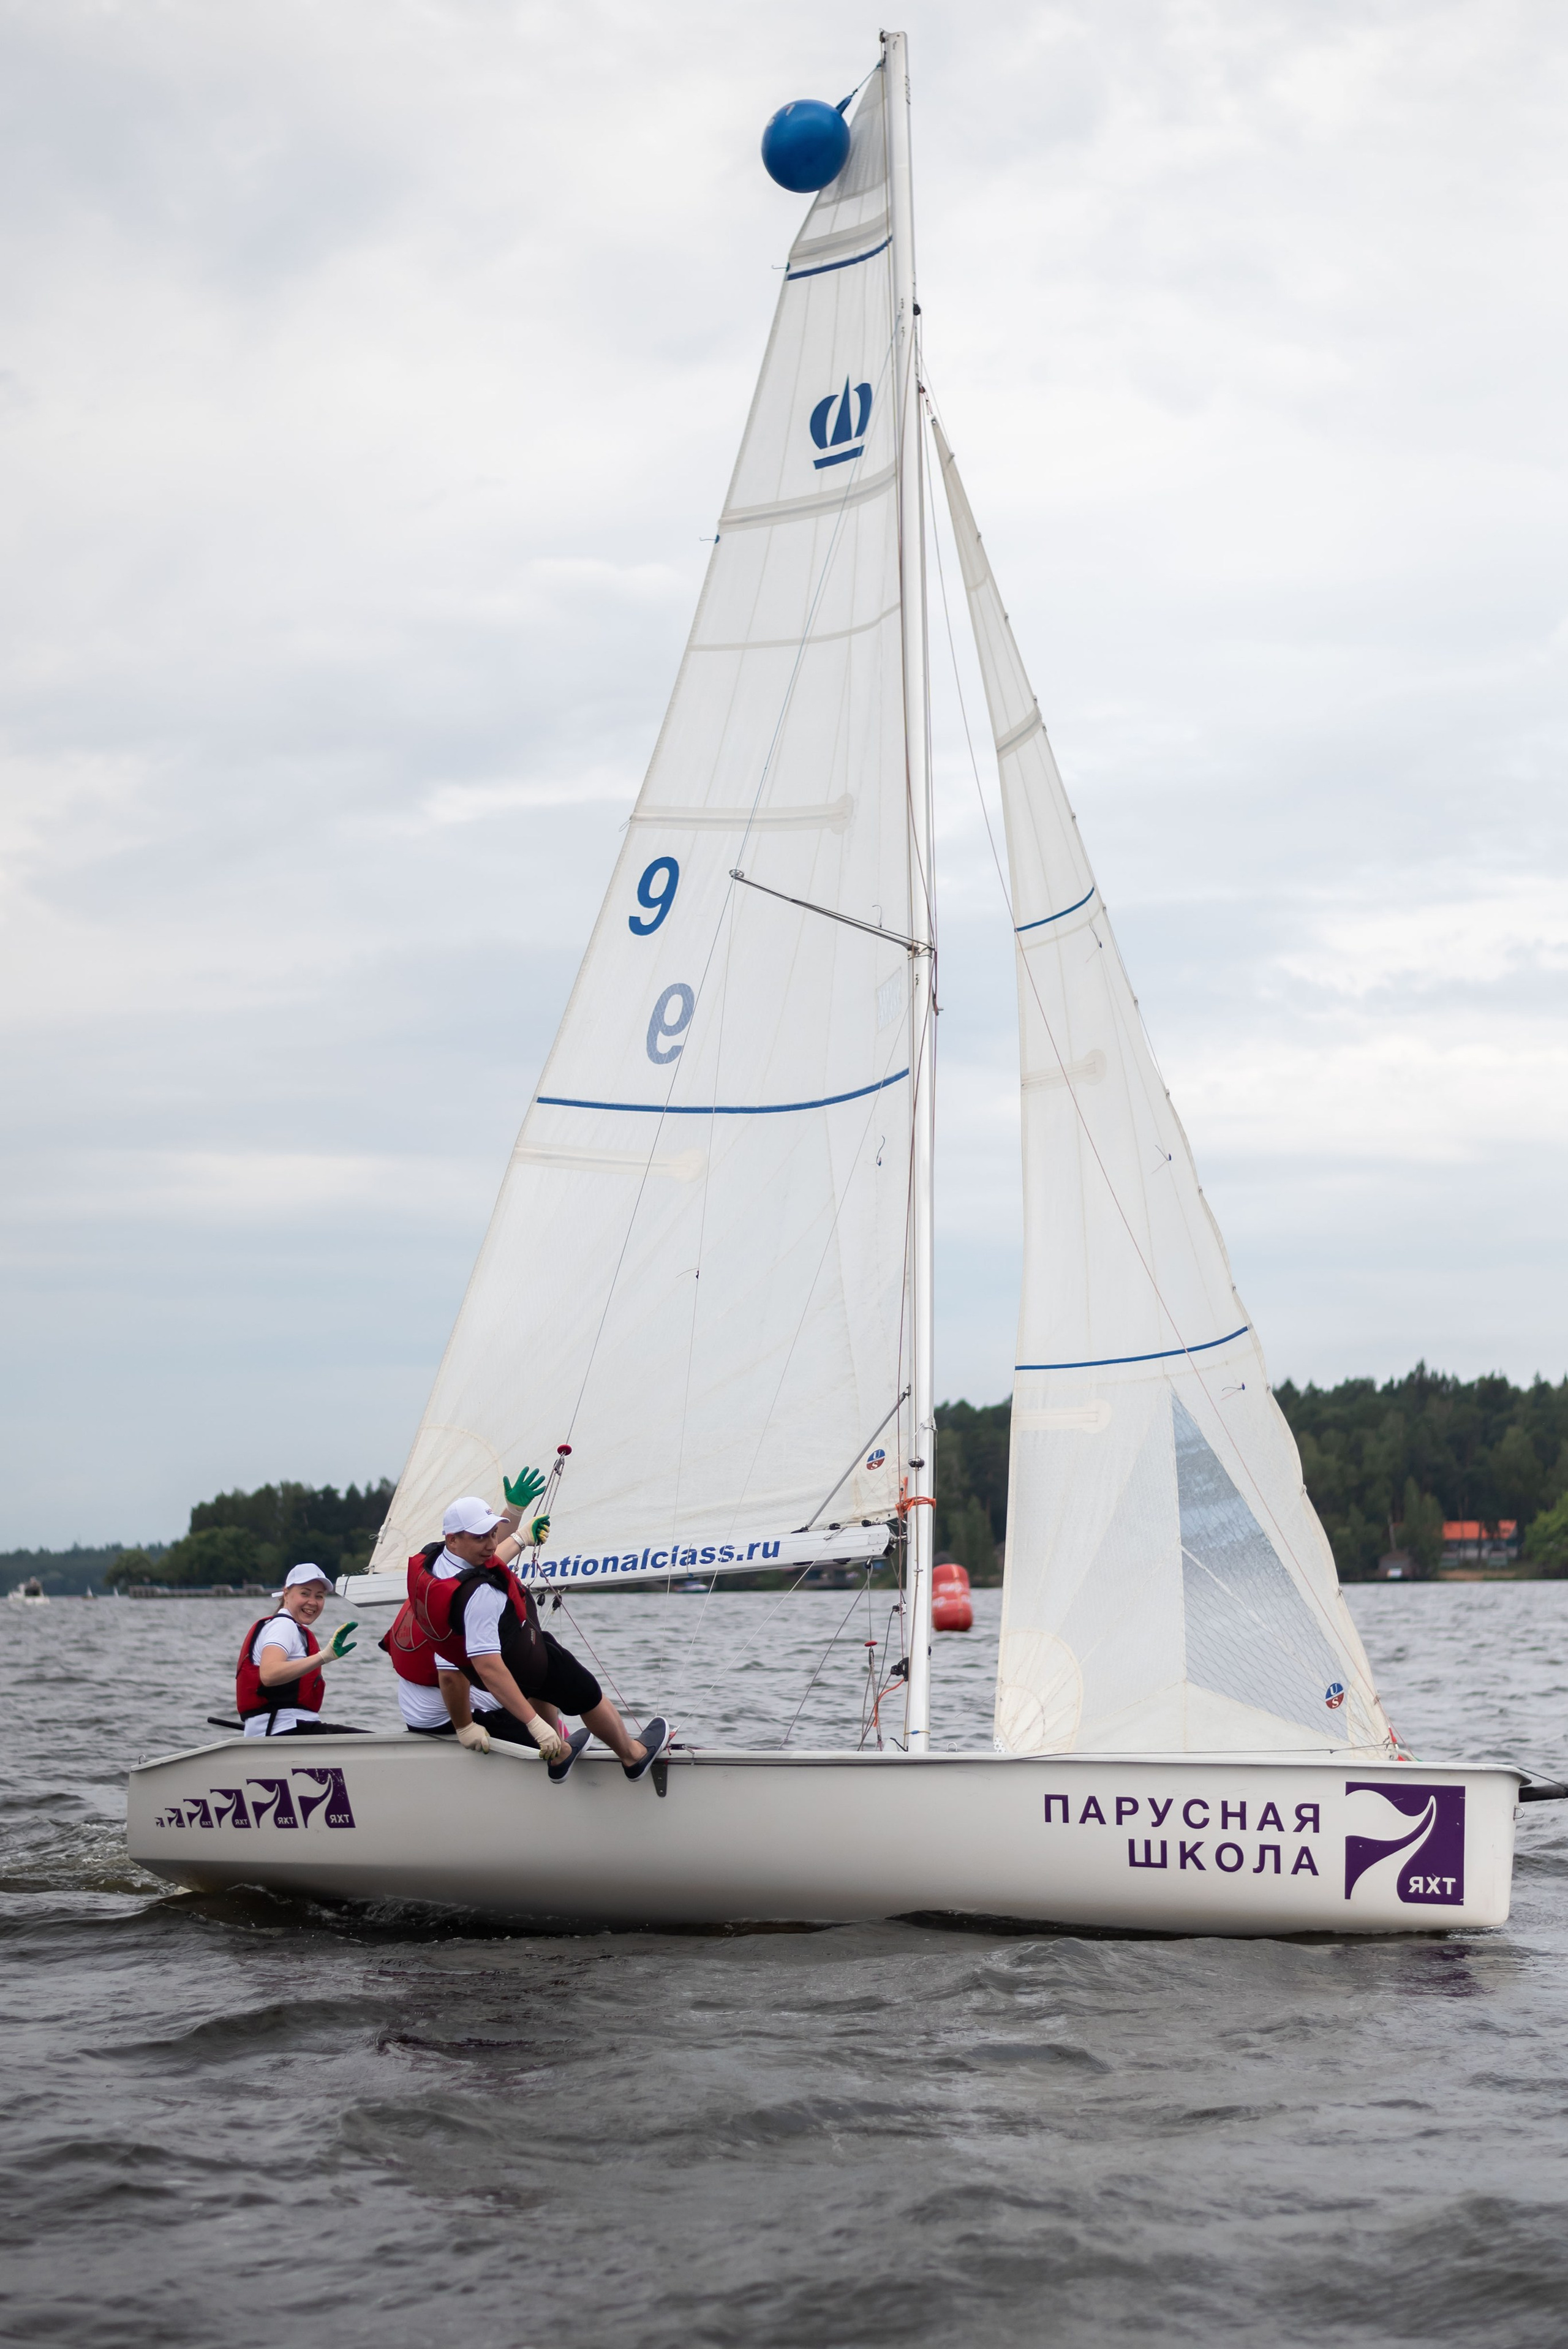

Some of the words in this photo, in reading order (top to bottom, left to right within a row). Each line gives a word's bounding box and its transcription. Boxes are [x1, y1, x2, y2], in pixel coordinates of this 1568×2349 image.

[628, 856, 679, 936] 9
[509, 1540, 780, 1579] nationalclass.ru
[330, 1814, 350, 1823] ЯХТ
[1043, 1793, 1320, 1833] ПАРУСНАЯ
[1128, 1839, 1319, 1876] ШКОЛА
[1408, 1876, 1456, 1895] ЯХТ
